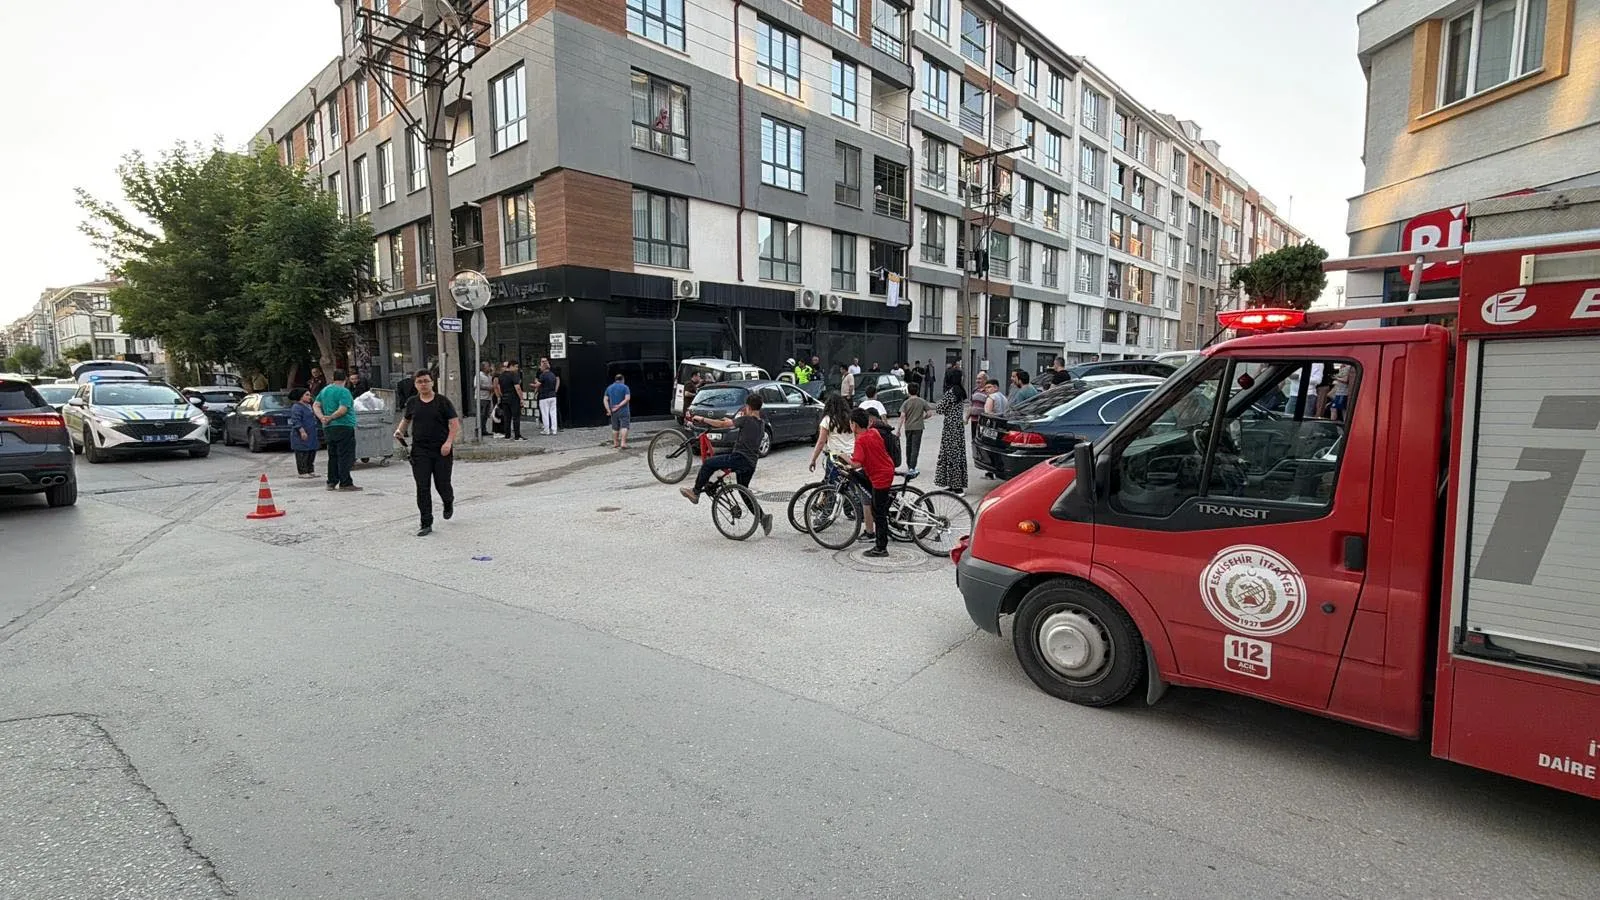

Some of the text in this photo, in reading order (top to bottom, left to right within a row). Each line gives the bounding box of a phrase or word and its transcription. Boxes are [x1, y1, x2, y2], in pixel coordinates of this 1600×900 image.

[1199, 504, 1270, 520] TRANSIT
[1211, 553, 1252, 586] ESKİŞEHİR
[1240, 618, 1258, 627] 1927
[1231, 639, 1264, 663] 112
[1538, 752, 1597, 780] DAİRE
